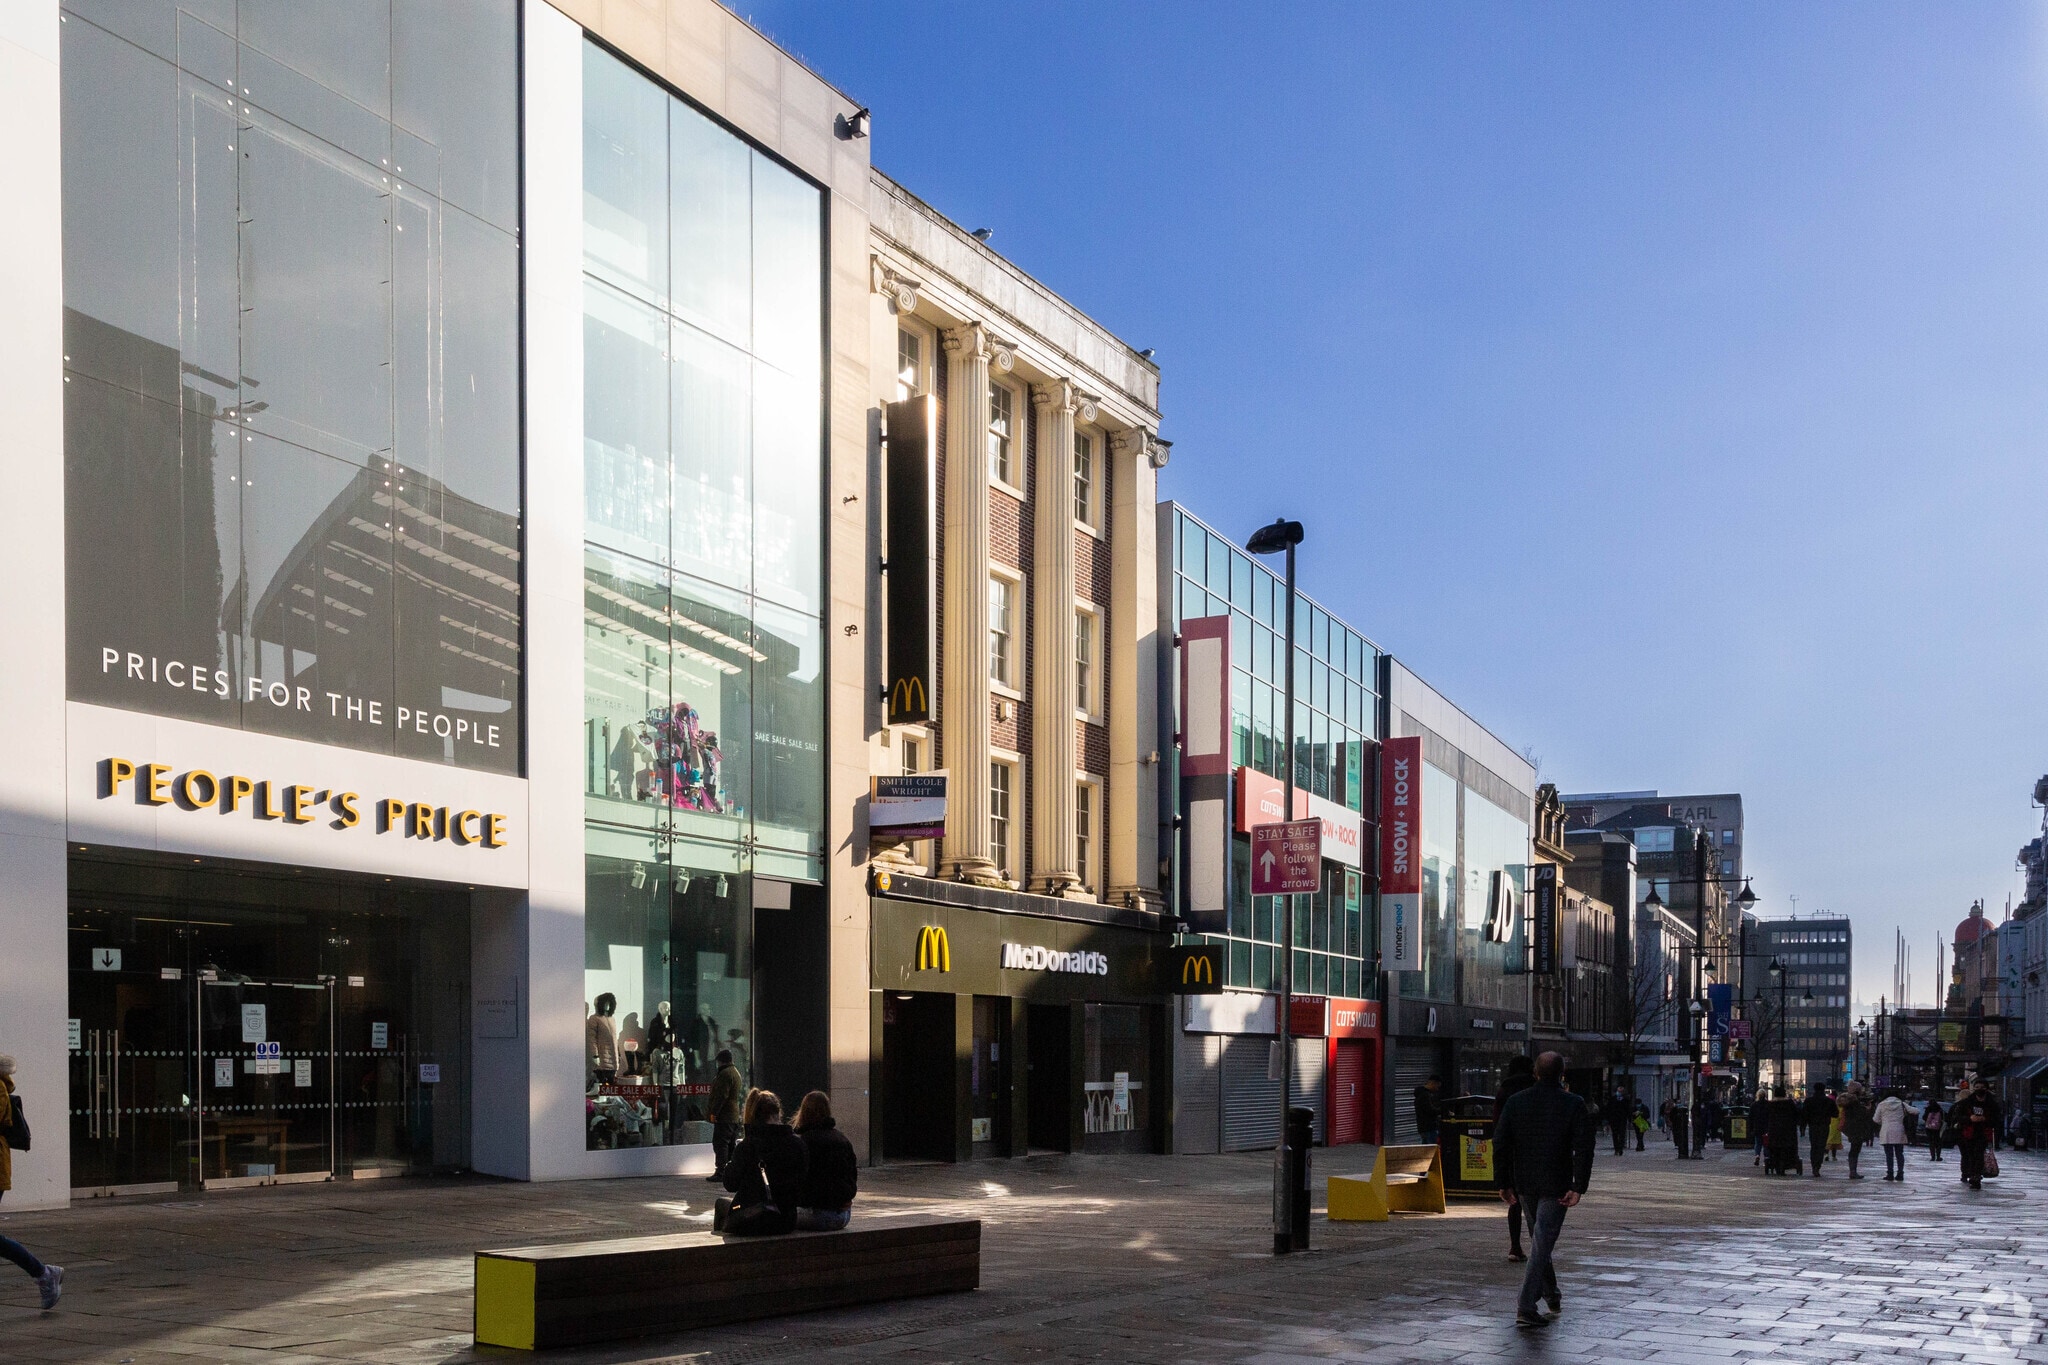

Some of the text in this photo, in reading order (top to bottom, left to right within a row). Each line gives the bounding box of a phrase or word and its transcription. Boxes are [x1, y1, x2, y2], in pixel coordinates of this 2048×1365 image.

[102, 647, 500, 747] PRICES FOR THE PEOPLE
[755, 731, 819, 751] SALE SALE SALE SALE
[880, 778, 943, 786] SMITH COLE
[1394, 757, 1409, 806] ROCK
[891, 787, 931, 795] WRIGHT
[96, 757, 507, 849] PEOPLE'S PRICE
[1260, 799, 1284, 818] COTSW
[1258, 826, 1315, 840] STAY SAFE
[1321, 818, 1334, 839] OW
[1338, 825, 1357, 848] ROCK
[1282, 842, 1316, 851] Please
[1394, 821, 1408, 874] SNOW
[1283, 854, 1315, 864] follow
[1291, 867, 1307, 875] the
[1537, 867, 1555, 880] JD
[1281, 879, 1315, 888] arrows
[1486, 870, 1514, 942] JD
[1541, 886, 1549, 928] TRAINERS
[1394, 904, 1403, 960] runnersneed
[1001, 943, 1108, 976] McDonald's
[1301, 996, 1311, 1004] TO
[1336, 1010, 1377, 1028] COTSWOLD
[1427, 1007, 1437, 1032] JD
[600, 1086, 660, 1095] SALE SALE SALE
[676, 1085, 711, 1094] SALE SALE
